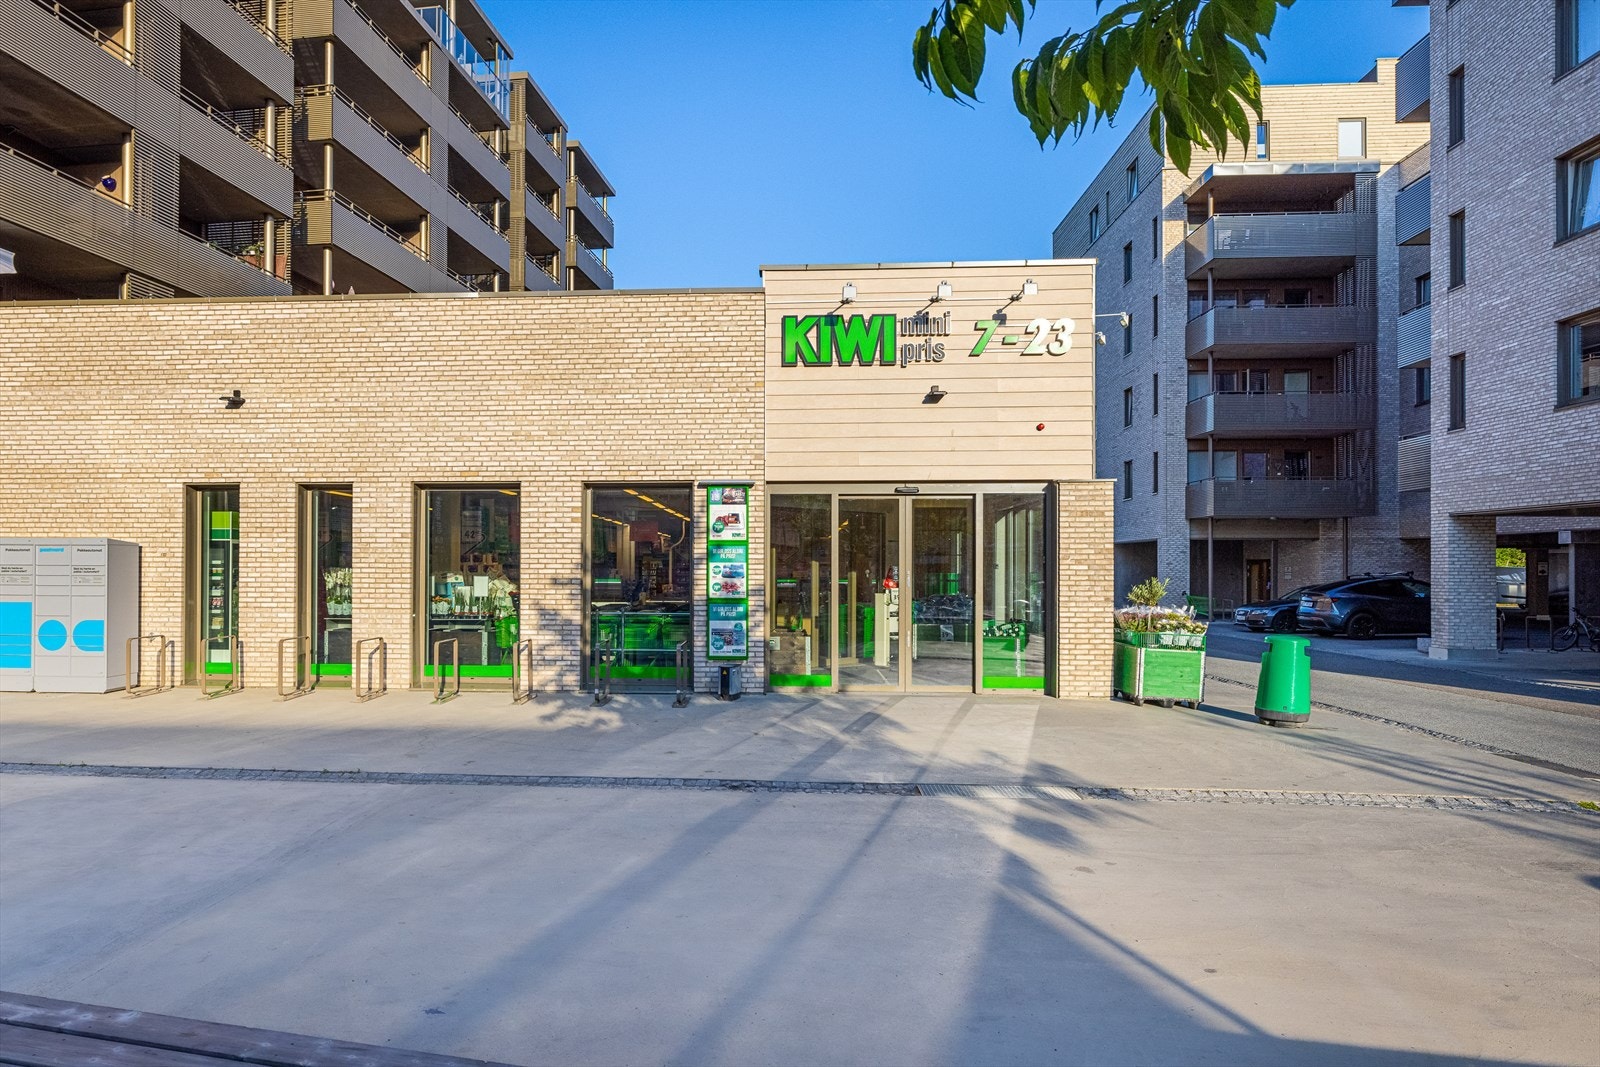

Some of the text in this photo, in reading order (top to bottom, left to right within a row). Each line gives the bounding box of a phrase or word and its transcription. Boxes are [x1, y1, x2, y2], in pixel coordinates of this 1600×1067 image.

[901, 311, 951, 337] mini
[782, 314, 897, 367] KIWI
[901, 338, 946, 368] pris
